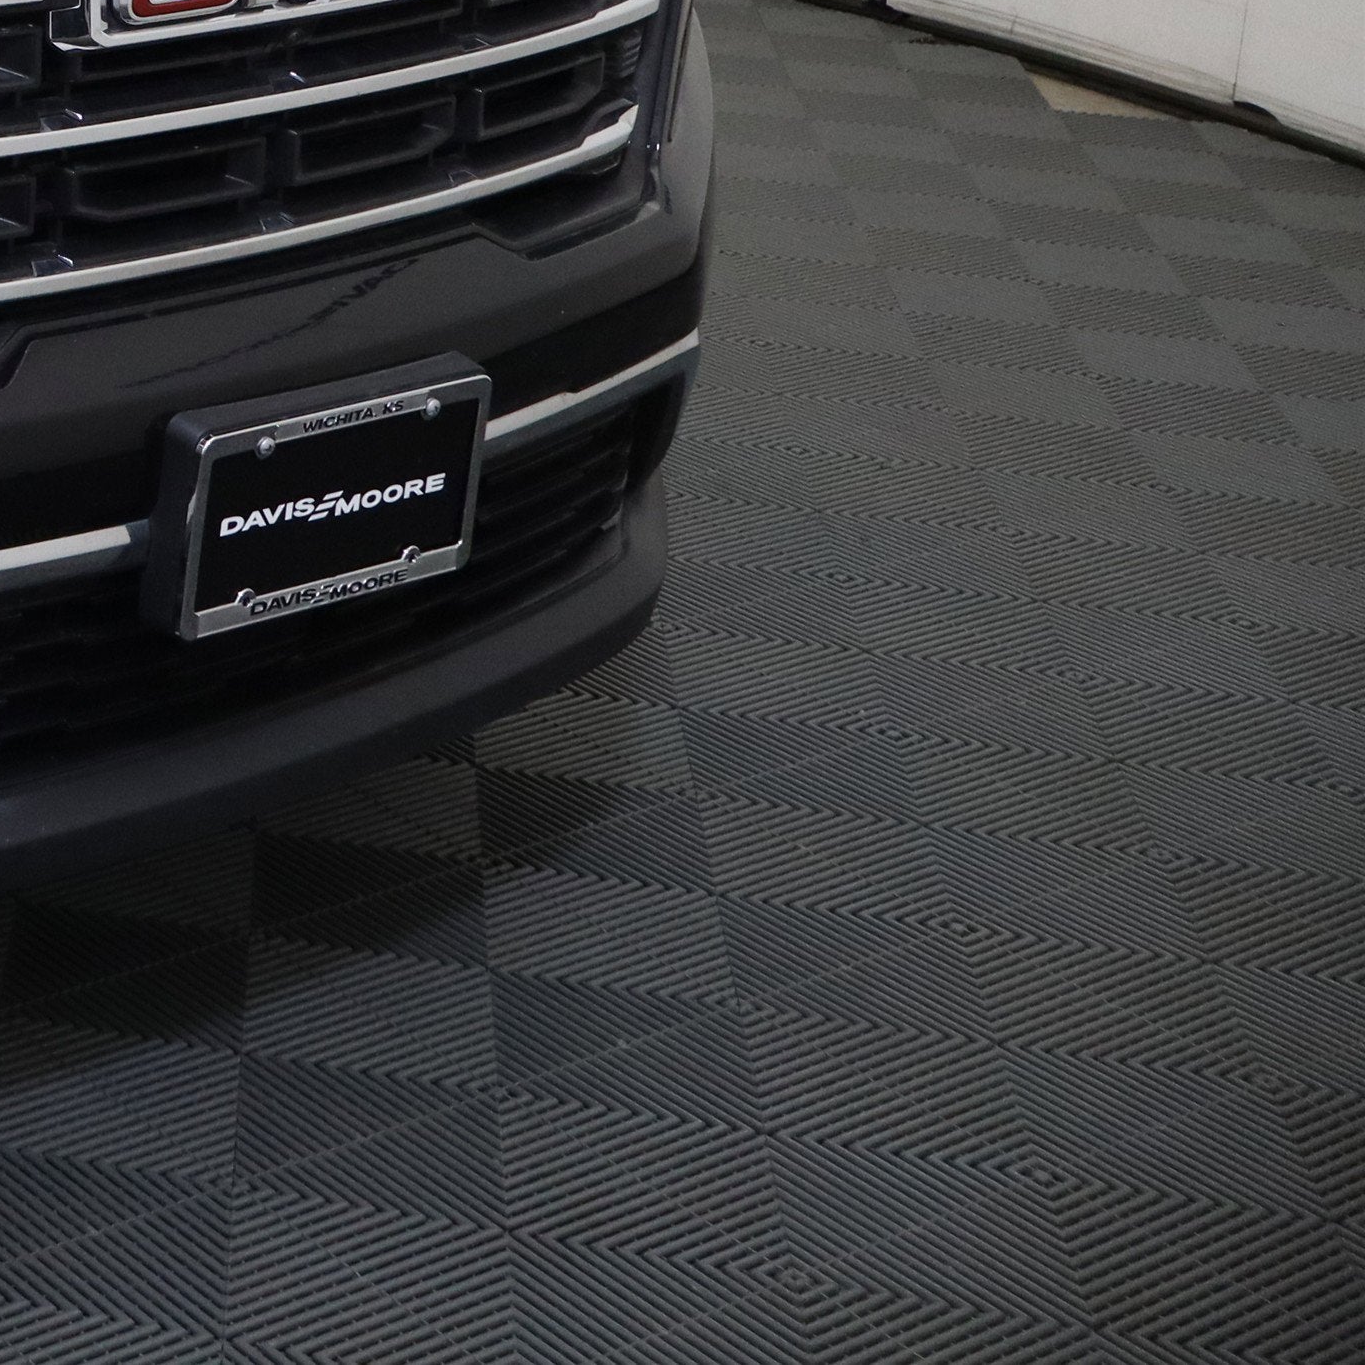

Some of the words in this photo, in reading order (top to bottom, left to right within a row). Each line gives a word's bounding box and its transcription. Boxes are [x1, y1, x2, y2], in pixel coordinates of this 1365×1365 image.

[382, 400, 405, 415] KS
[219, 496, 317, 537] DAVIS
[334, 472, 447, 517] MOORE
[249, 587, 317, 617] DAVIS
[327, 568, 409, 601] MOORE
